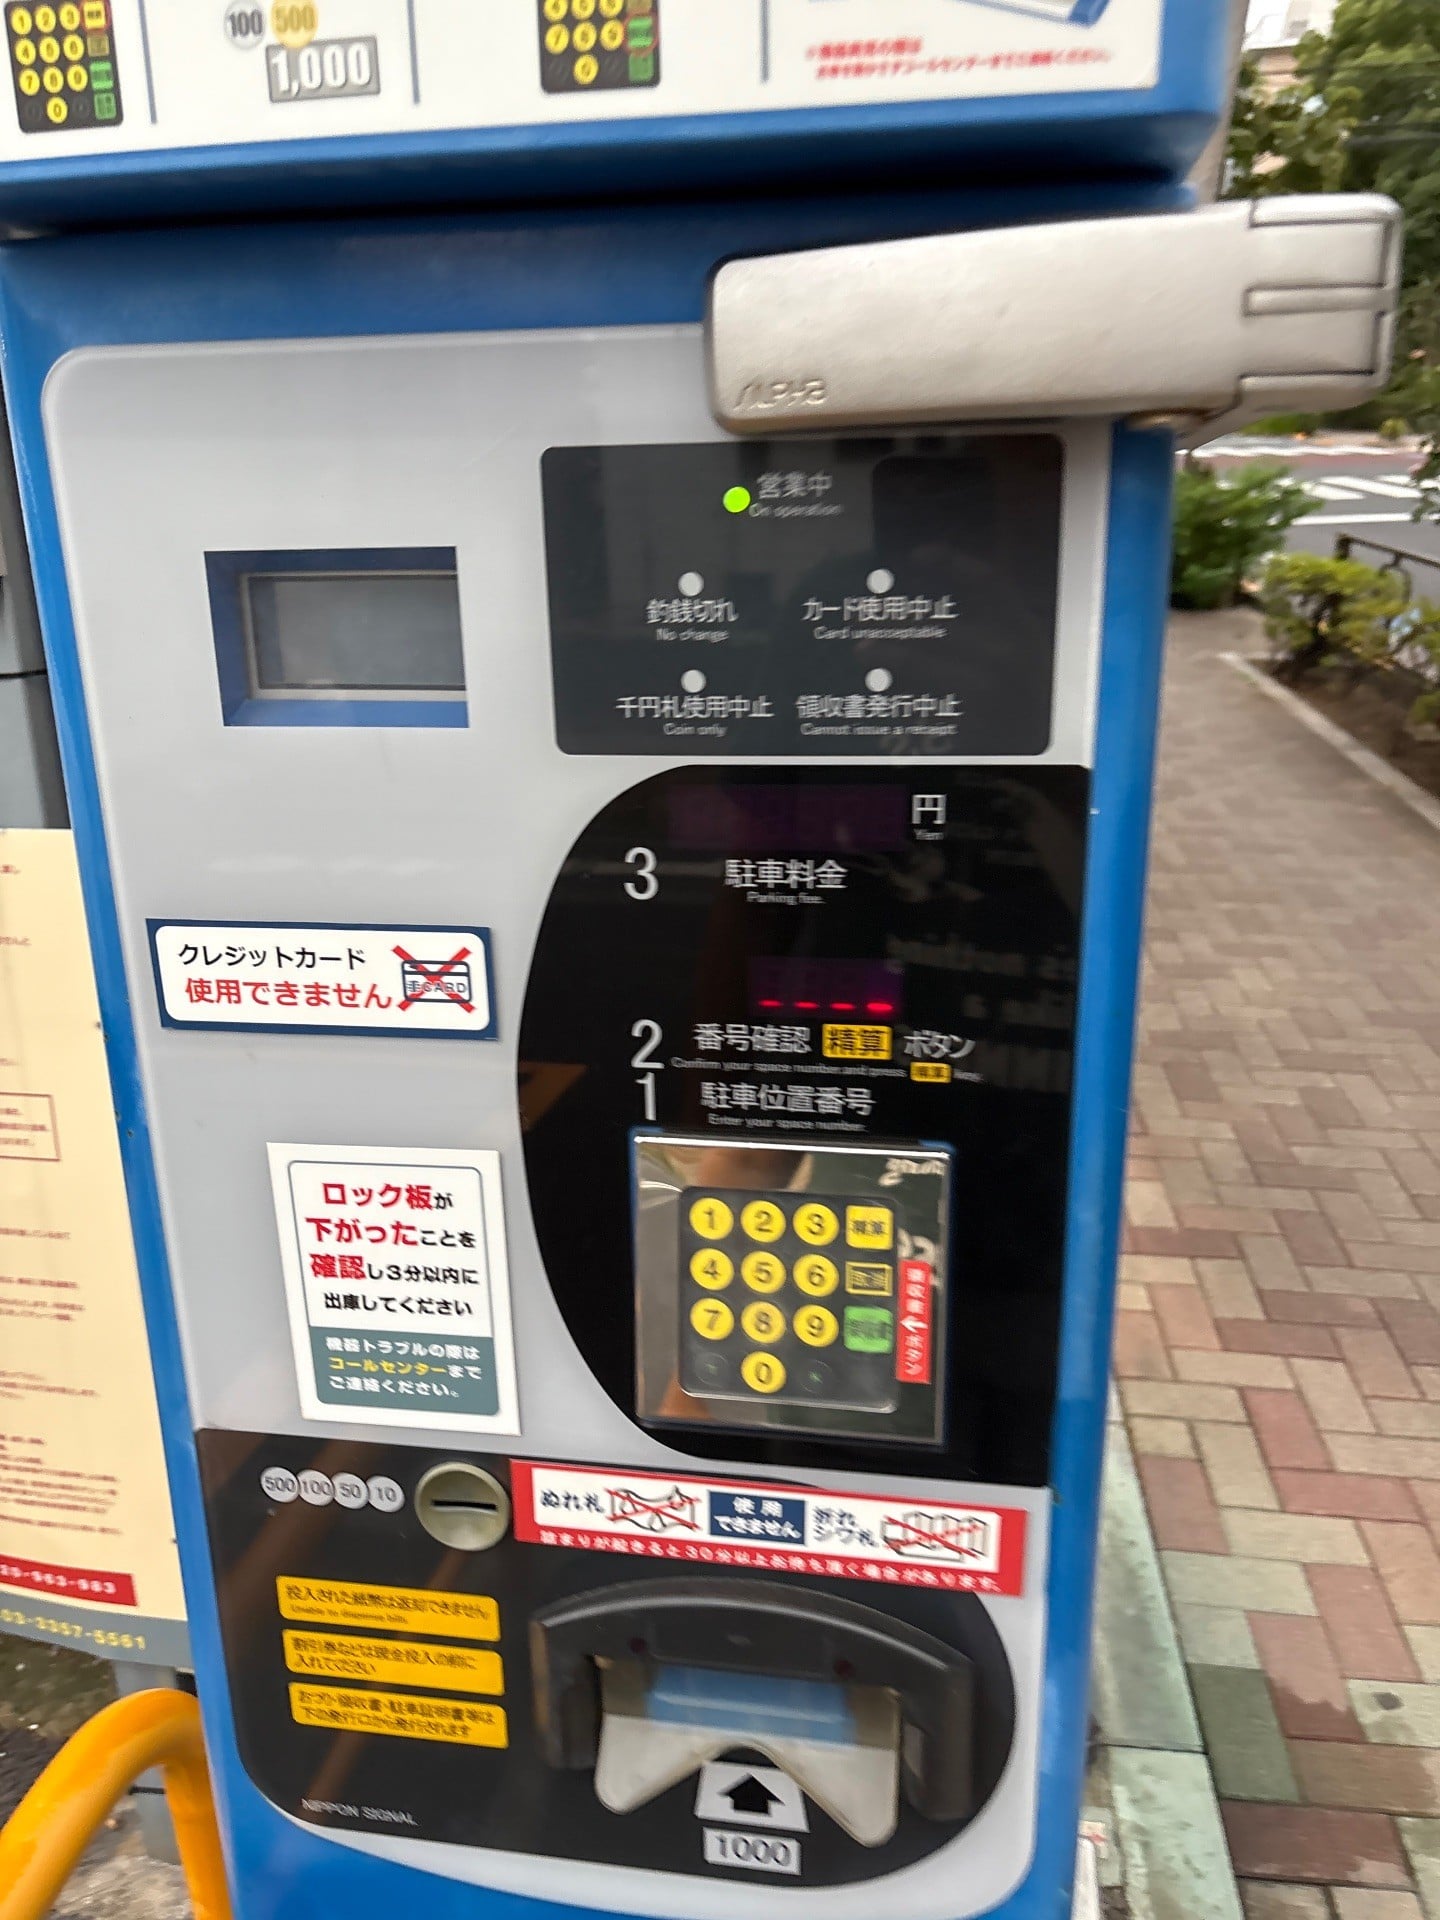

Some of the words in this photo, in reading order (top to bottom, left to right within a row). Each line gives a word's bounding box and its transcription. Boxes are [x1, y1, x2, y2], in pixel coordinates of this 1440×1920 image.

[230, 11, 263, 37] 100
[272, 43, 371, 94] 1,000
[757, 471, 832, 500] 営業中
[646, 598, 738, 625] 釣銭切れ
[801, 595, 960, 621] カード使用中止
[616, 694, 774, 720] 千円札使用中止
[795, 693, 964, 719] 領収書発行中止
[911, 794, 947, 826] 円
[623, 846, 659, 900] 3
[724, 858, 848, 889] 駐車料金
[178, 944, 367, 970] クレジットカード
[185, 977, 393, 1010] 使用できません
[422, 981, 467, 993] CARD
[631, 1019, 664, 1069] 2
[694, 1022, 812, 1054] 番号確認
[826, 1025, 891, 1058] 精算
[903, 1029, 977, 1060] ボタン
[635, 1072, 657, 1121] 1
[700, 1081, 877, 1117] 駐車位置番号
[322, 1182, 453, 1210] ロック板が
[306, 1217, 476, 1249] 下がったことを
[705, 1206, 717, 1229] 1
[754, 1210, 773, 1232] 2
[806, 1213, 826, 1235] 3
[309, 1253, 479, 1285] 確認し3分以内に
[703, 1259, 721, 1280] 4
[754, 1262, 772, 1283] 5
[806, 1265, 826, 1287] 6
[324, 1292, 472, 1317] 出庫してください
[704, 1308, 722, 1330] 7
[754, 1311, 772, 1333] 8
[806, 1315, 826, 1338] 9
[328, 1357, 482, 1380] コールセンターまで
[755, 1362, 773, 1385] 0
[265, 1477, 295, 1493] 500
[301, 1478, 332, 1495] 100
[340, 1483, 362, 1499] 50
[375, 1486, 396, 1502] 10
[541, 1489, 605, 1513] ぬれ札
[714, 1515, 802, 1540] できません
[716, 1836, 792, 1867] 1000
